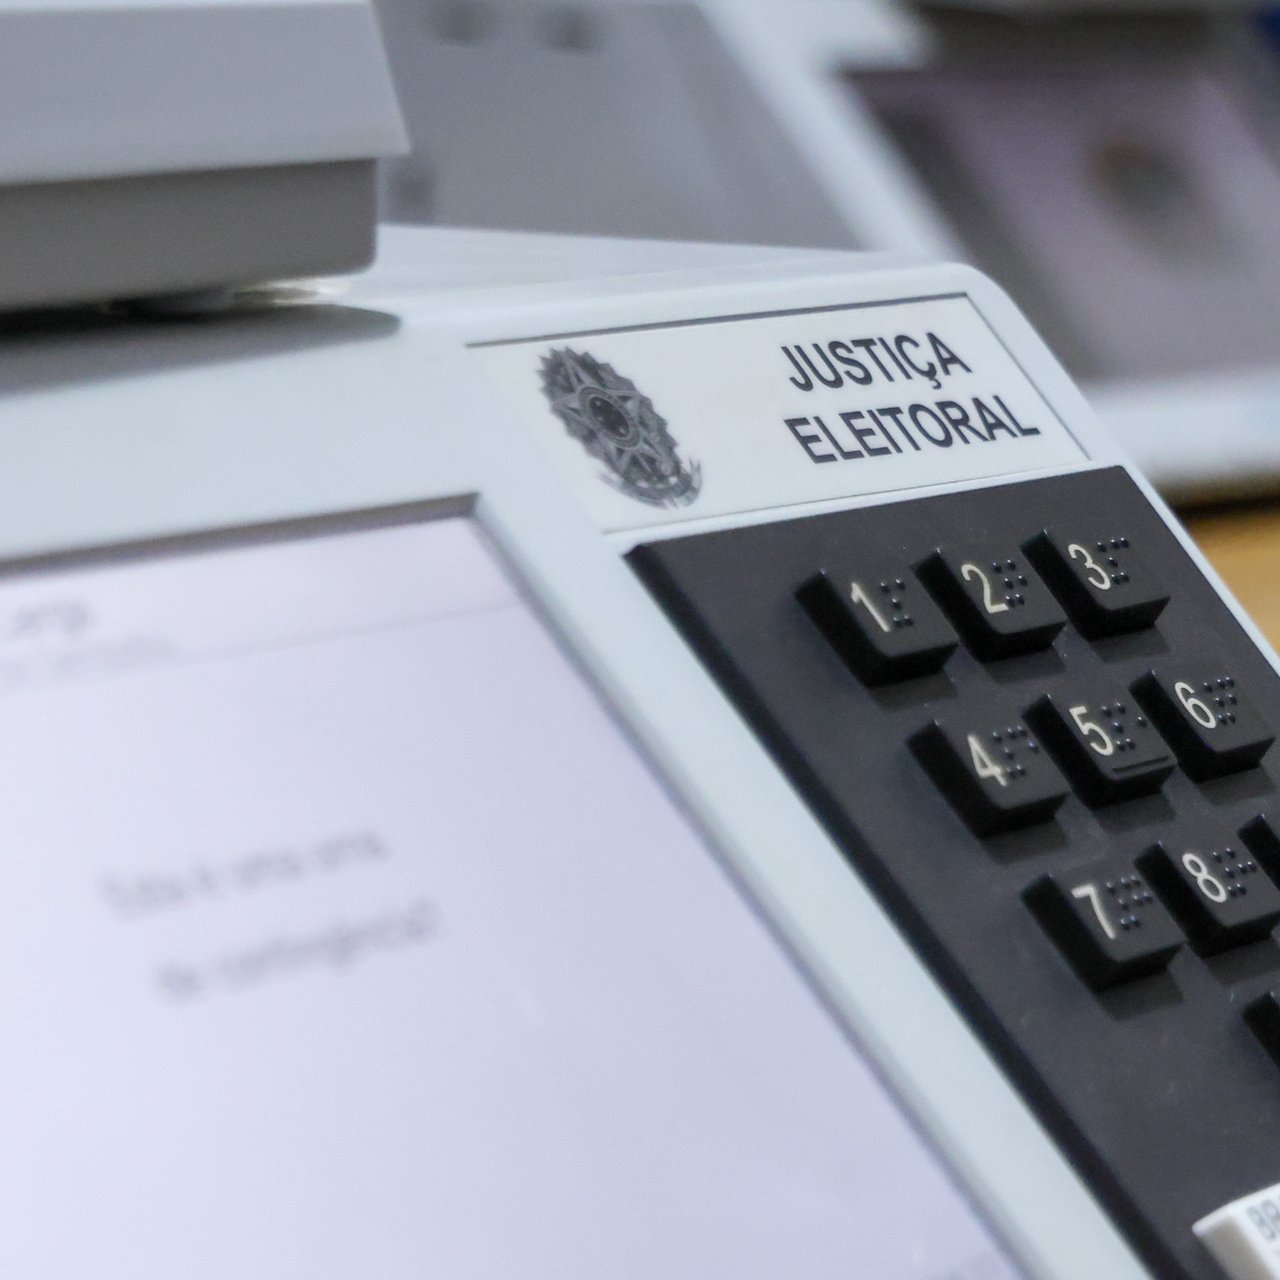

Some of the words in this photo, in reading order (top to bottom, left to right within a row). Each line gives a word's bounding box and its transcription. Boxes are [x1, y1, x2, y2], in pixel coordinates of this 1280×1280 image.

[779, 330, 973, 389] JUSTIÇA
[784, 394, 1041, 464] ELEITORAL
[850, 581, 891, 633] 1
[960, 563, 1009, 614] 2
[1067, 543, 1112, 590] 3
[967, 734, 1007, 787] 4
[1068, 705, 1115, 756] 5
[1174, 681, 1217, 729] 6
[1071, 883, 1116, 939] 7
[1181, 852, 1228, 903] 8
